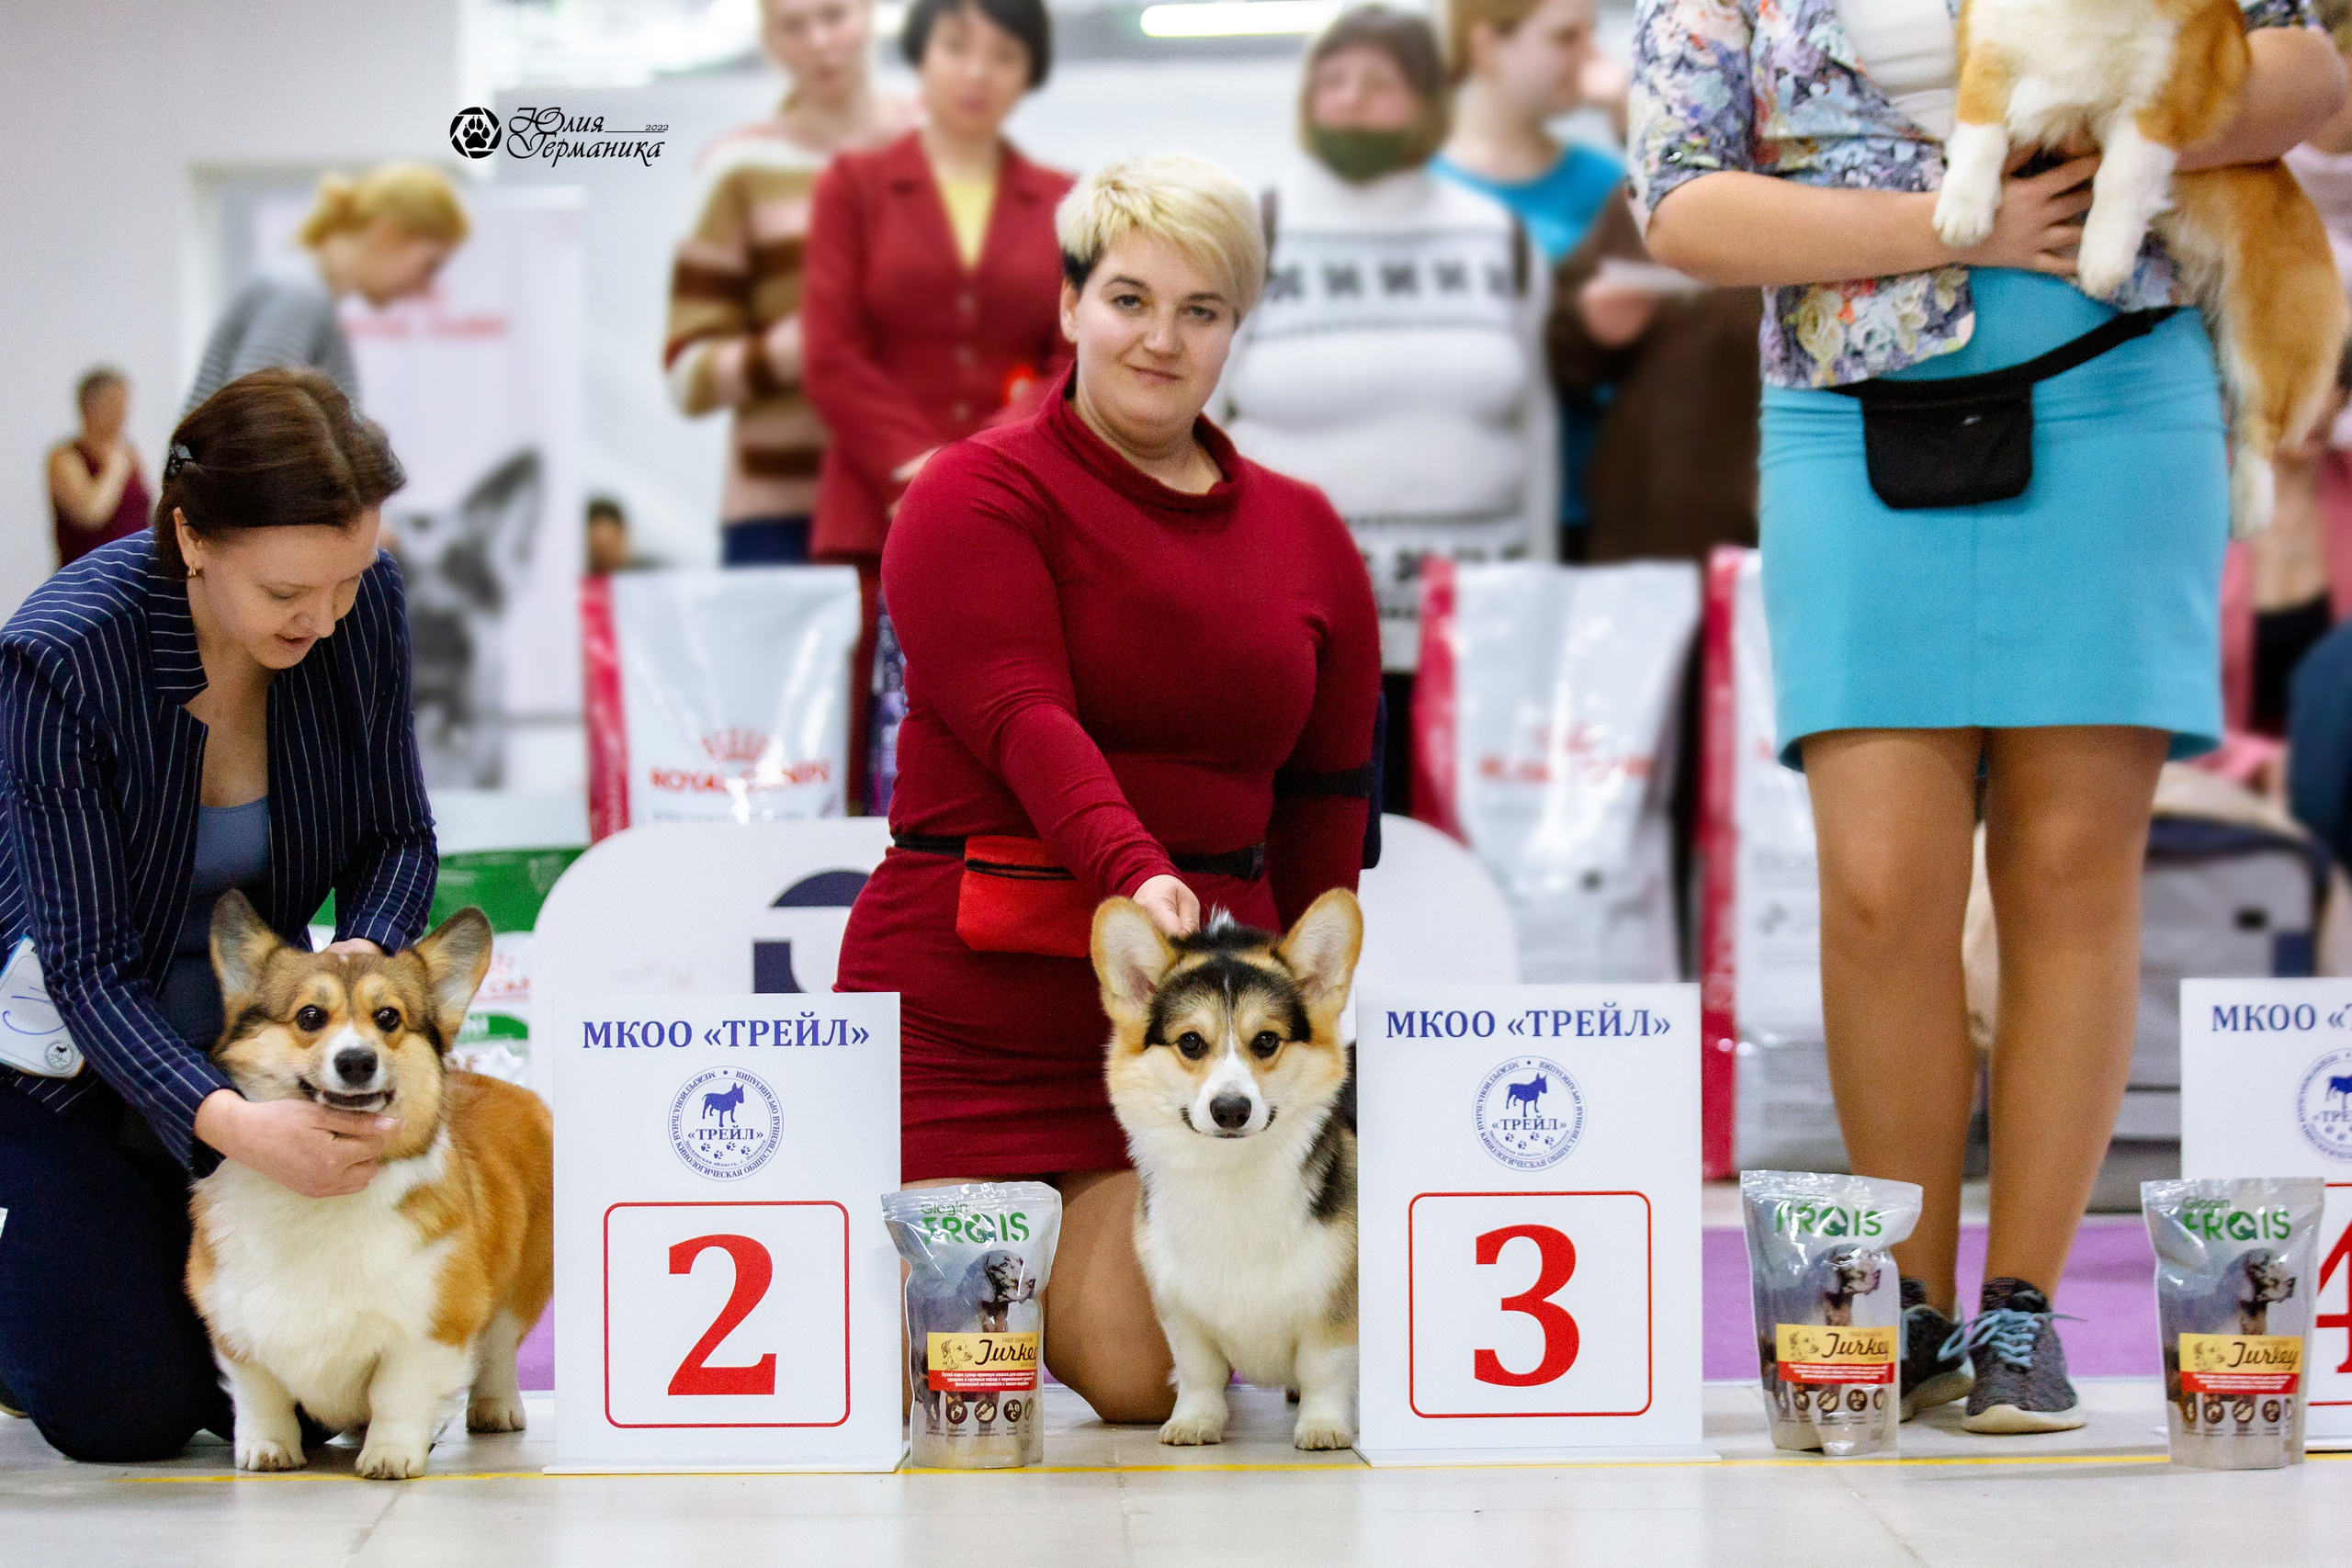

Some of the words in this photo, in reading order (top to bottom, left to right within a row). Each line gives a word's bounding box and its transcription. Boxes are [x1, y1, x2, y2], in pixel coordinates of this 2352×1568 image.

[582, 1020, 693, 1049] МКОО
[704, 1011, 870, 1047] «ТРЕЙЛ»
[1385, 1010, 1496, 1038] МКОО
[1508, 1001, 1670, 1037] «ТРЕЙЛ»
[2211, 1003, 2316, 1032] МКОО
[736, 1070, 779, 1114] ОРГАНИЗАЦИЯ
[687, 1124, 763, 1140] «ТРЕЙЛ»
[1491, 1114, 1567, 1131] «ТРЕЙЛ»
[675, 1141, 743, 1179] КИНОЛОГИЧЕСКАЯ
[743, 1115, 780, 1173] ОБЩЕСТВЕННАЯ
[668, 1234, 777, 1395] 2
[1474, 1224, 1579, 1386] 3
